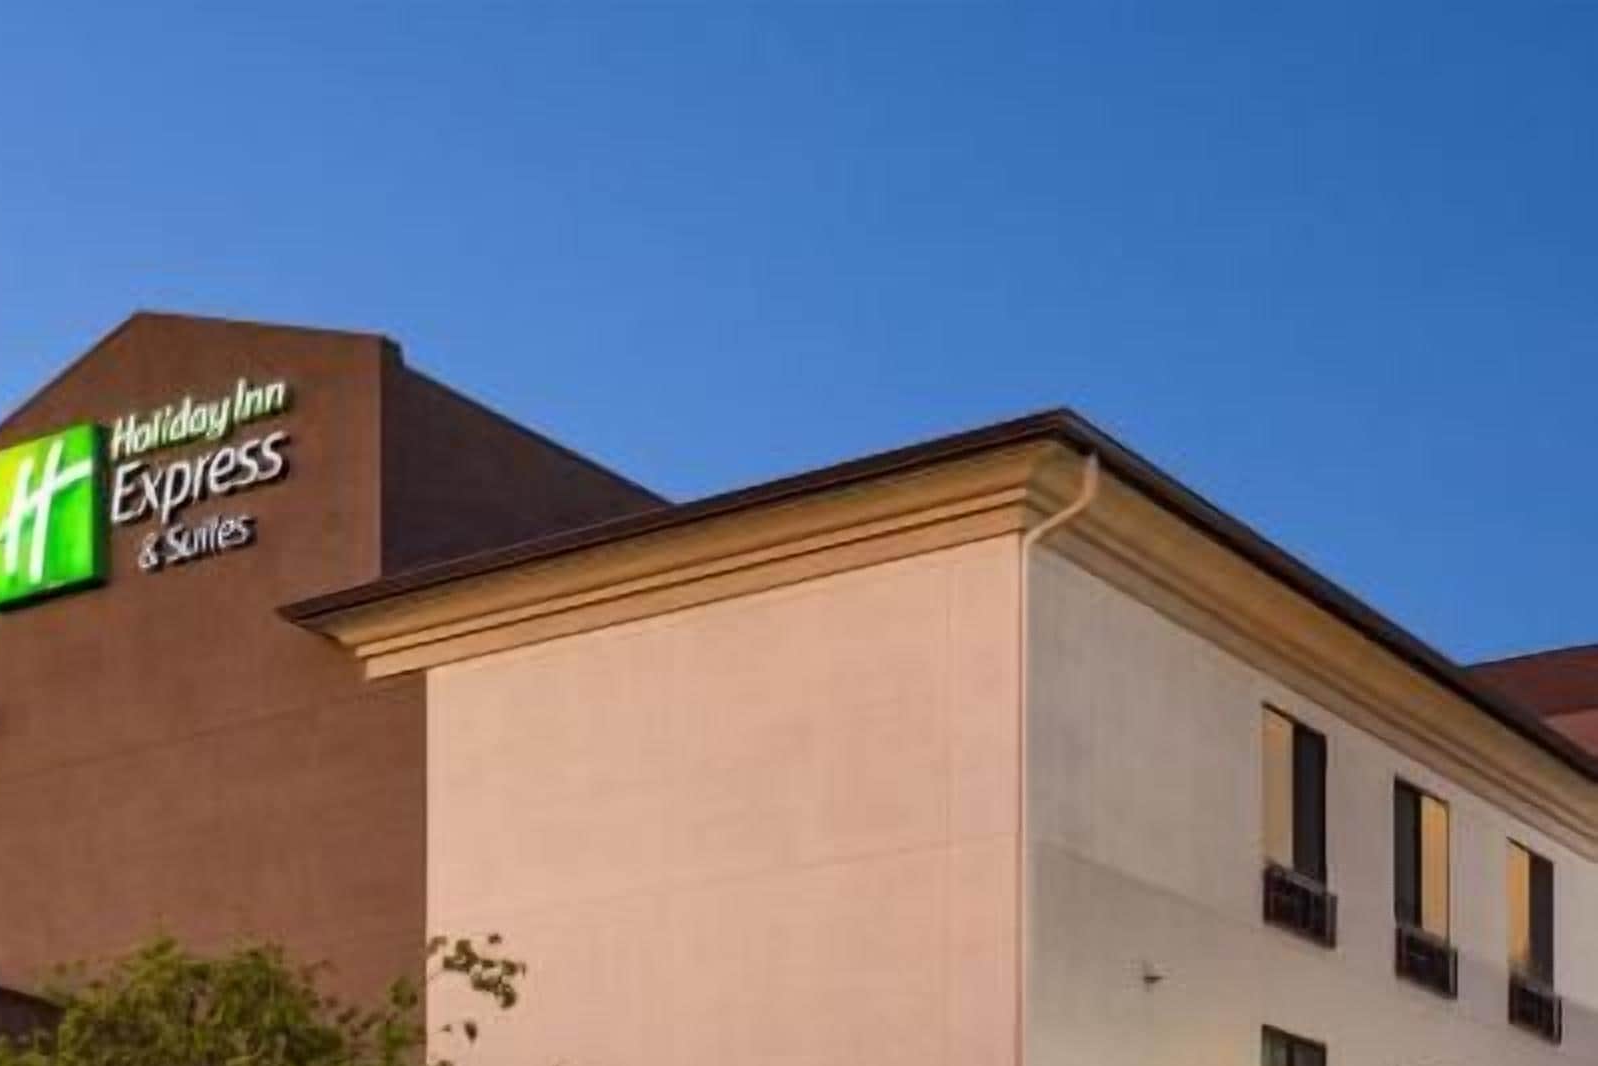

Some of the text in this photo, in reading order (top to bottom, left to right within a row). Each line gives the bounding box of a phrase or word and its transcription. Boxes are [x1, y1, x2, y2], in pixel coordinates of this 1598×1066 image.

[111, 377, 288, 460] Holiday Inn
[110, 430, 291, 524] Express
[138, 514, 253, 571] & Suites
